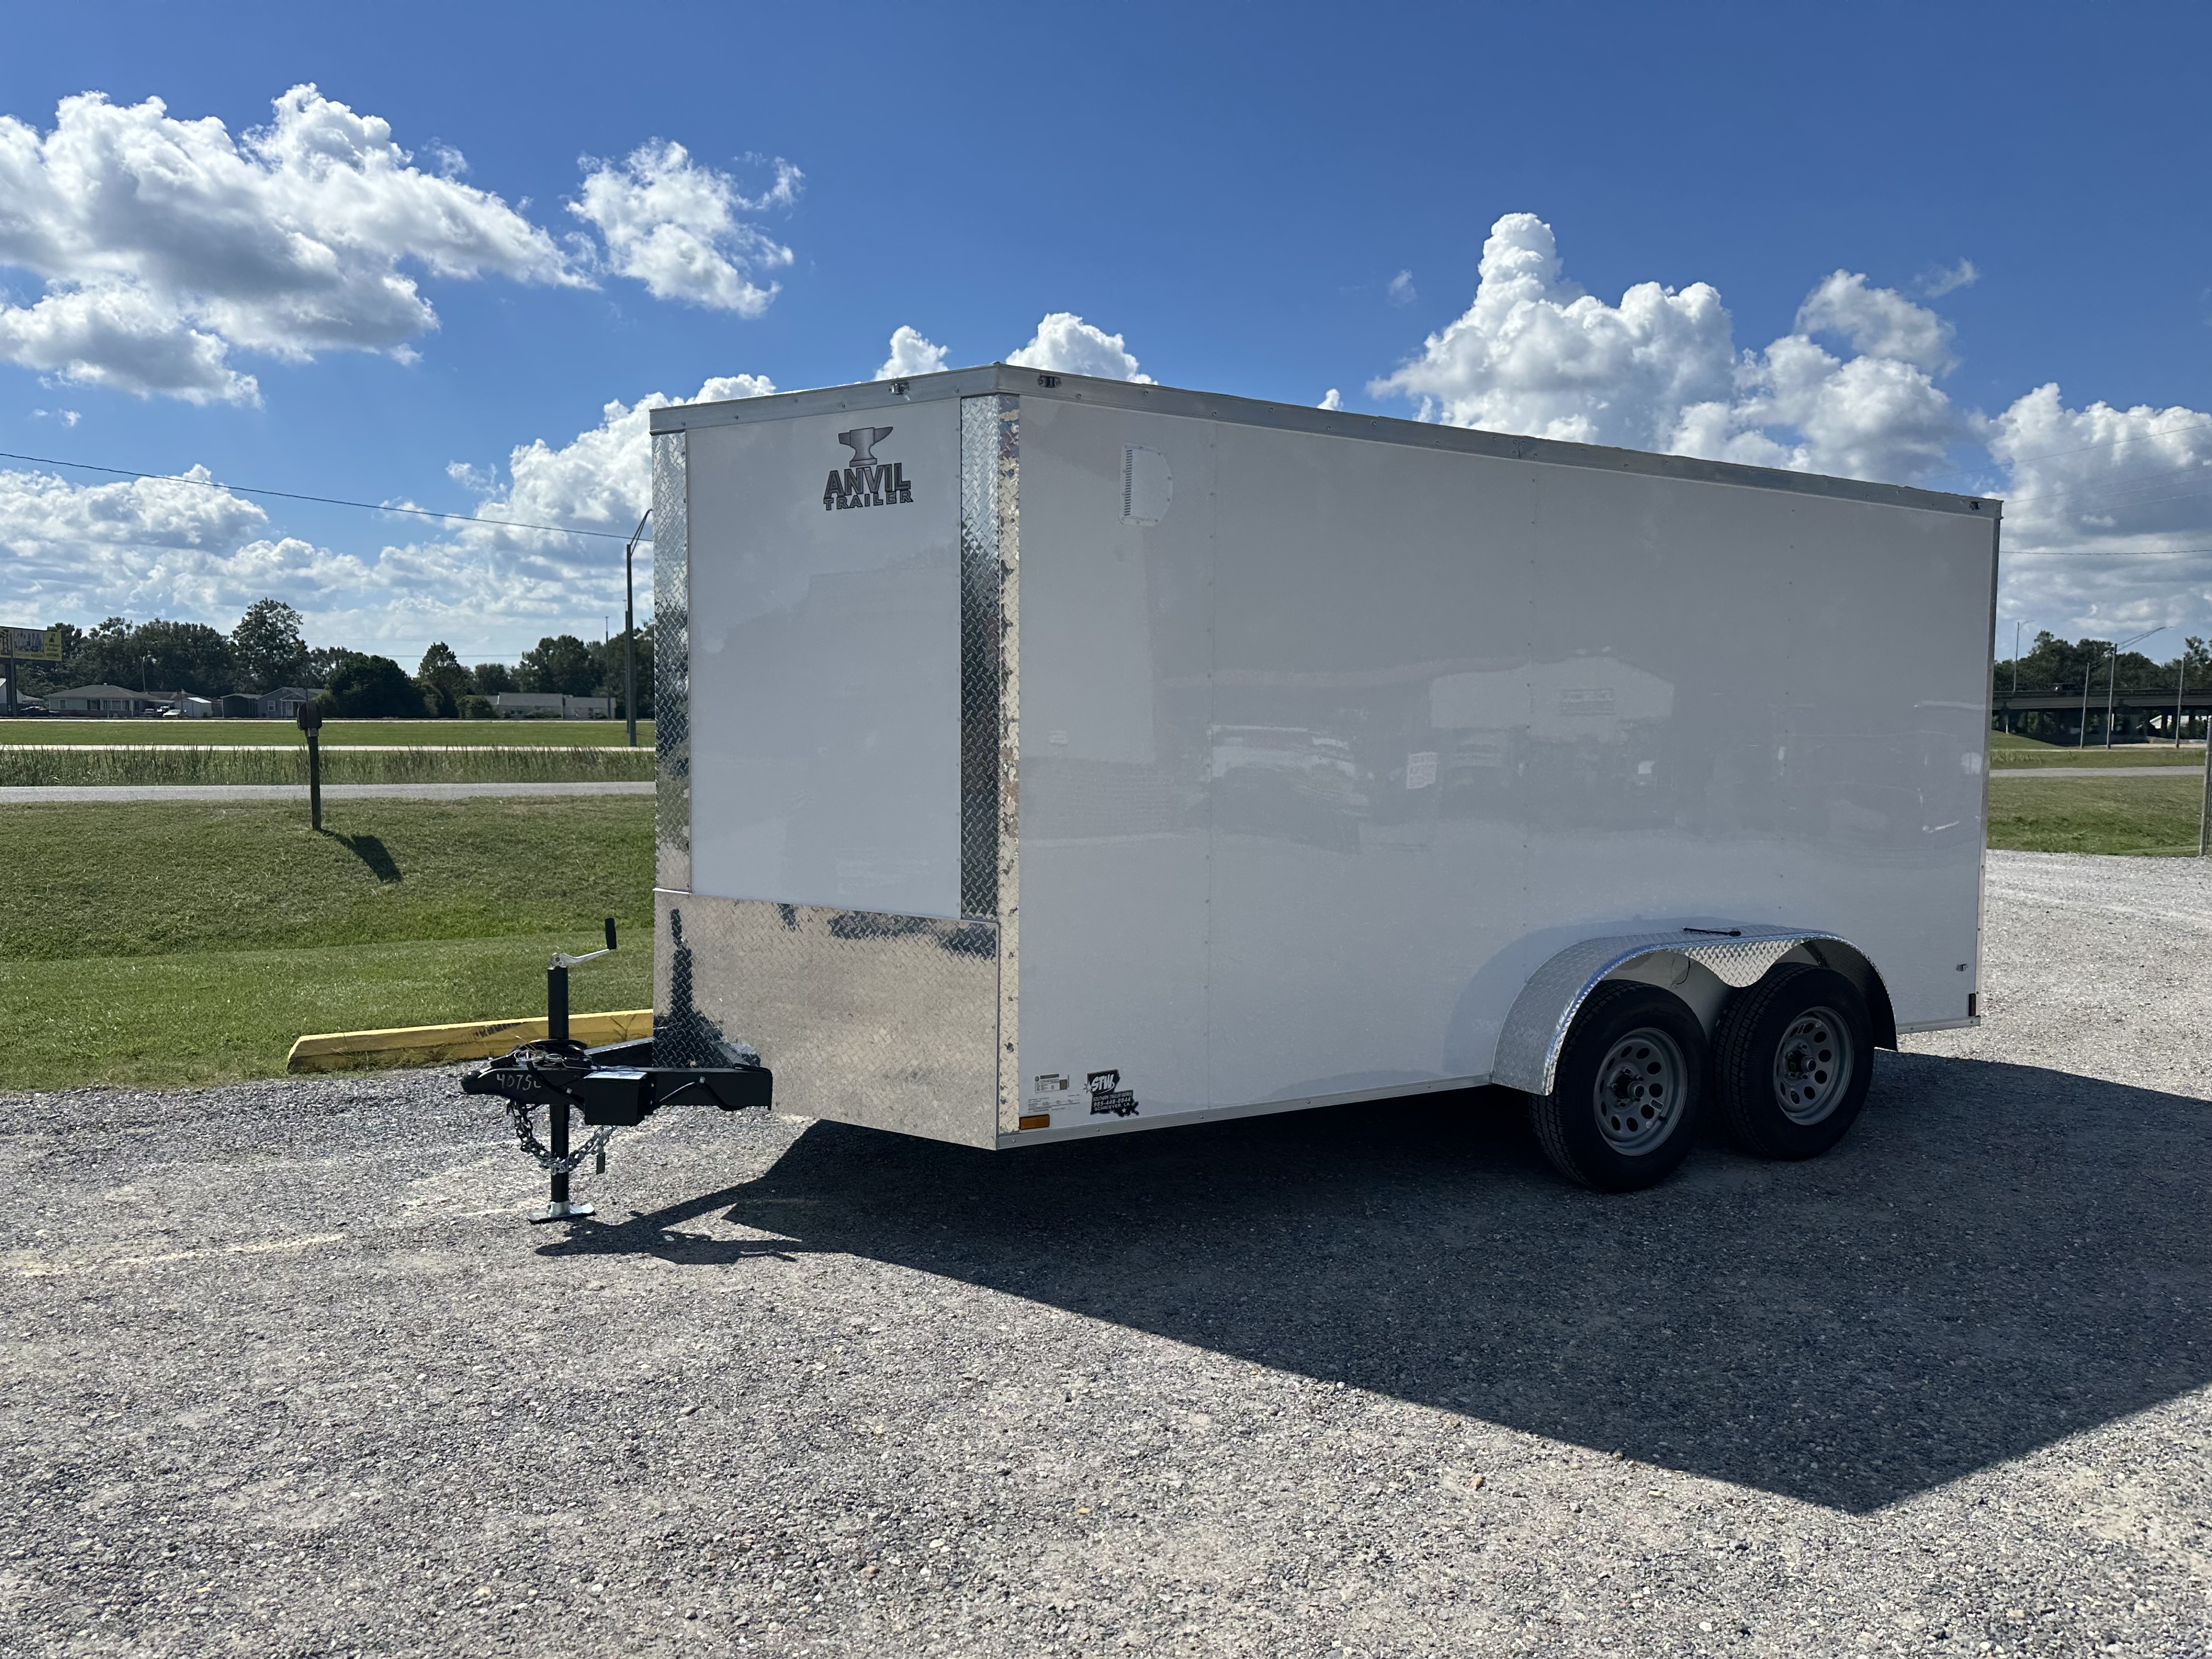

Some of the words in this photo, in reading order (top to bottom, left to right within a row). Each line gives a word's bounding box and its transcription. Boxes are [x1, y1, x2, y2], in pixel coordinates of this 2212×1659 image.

[823, 462, 911, 498] ANVIL
[823, 490, 913, 511] TRAILER
[1091, 1074, 1114, 1092] STW
